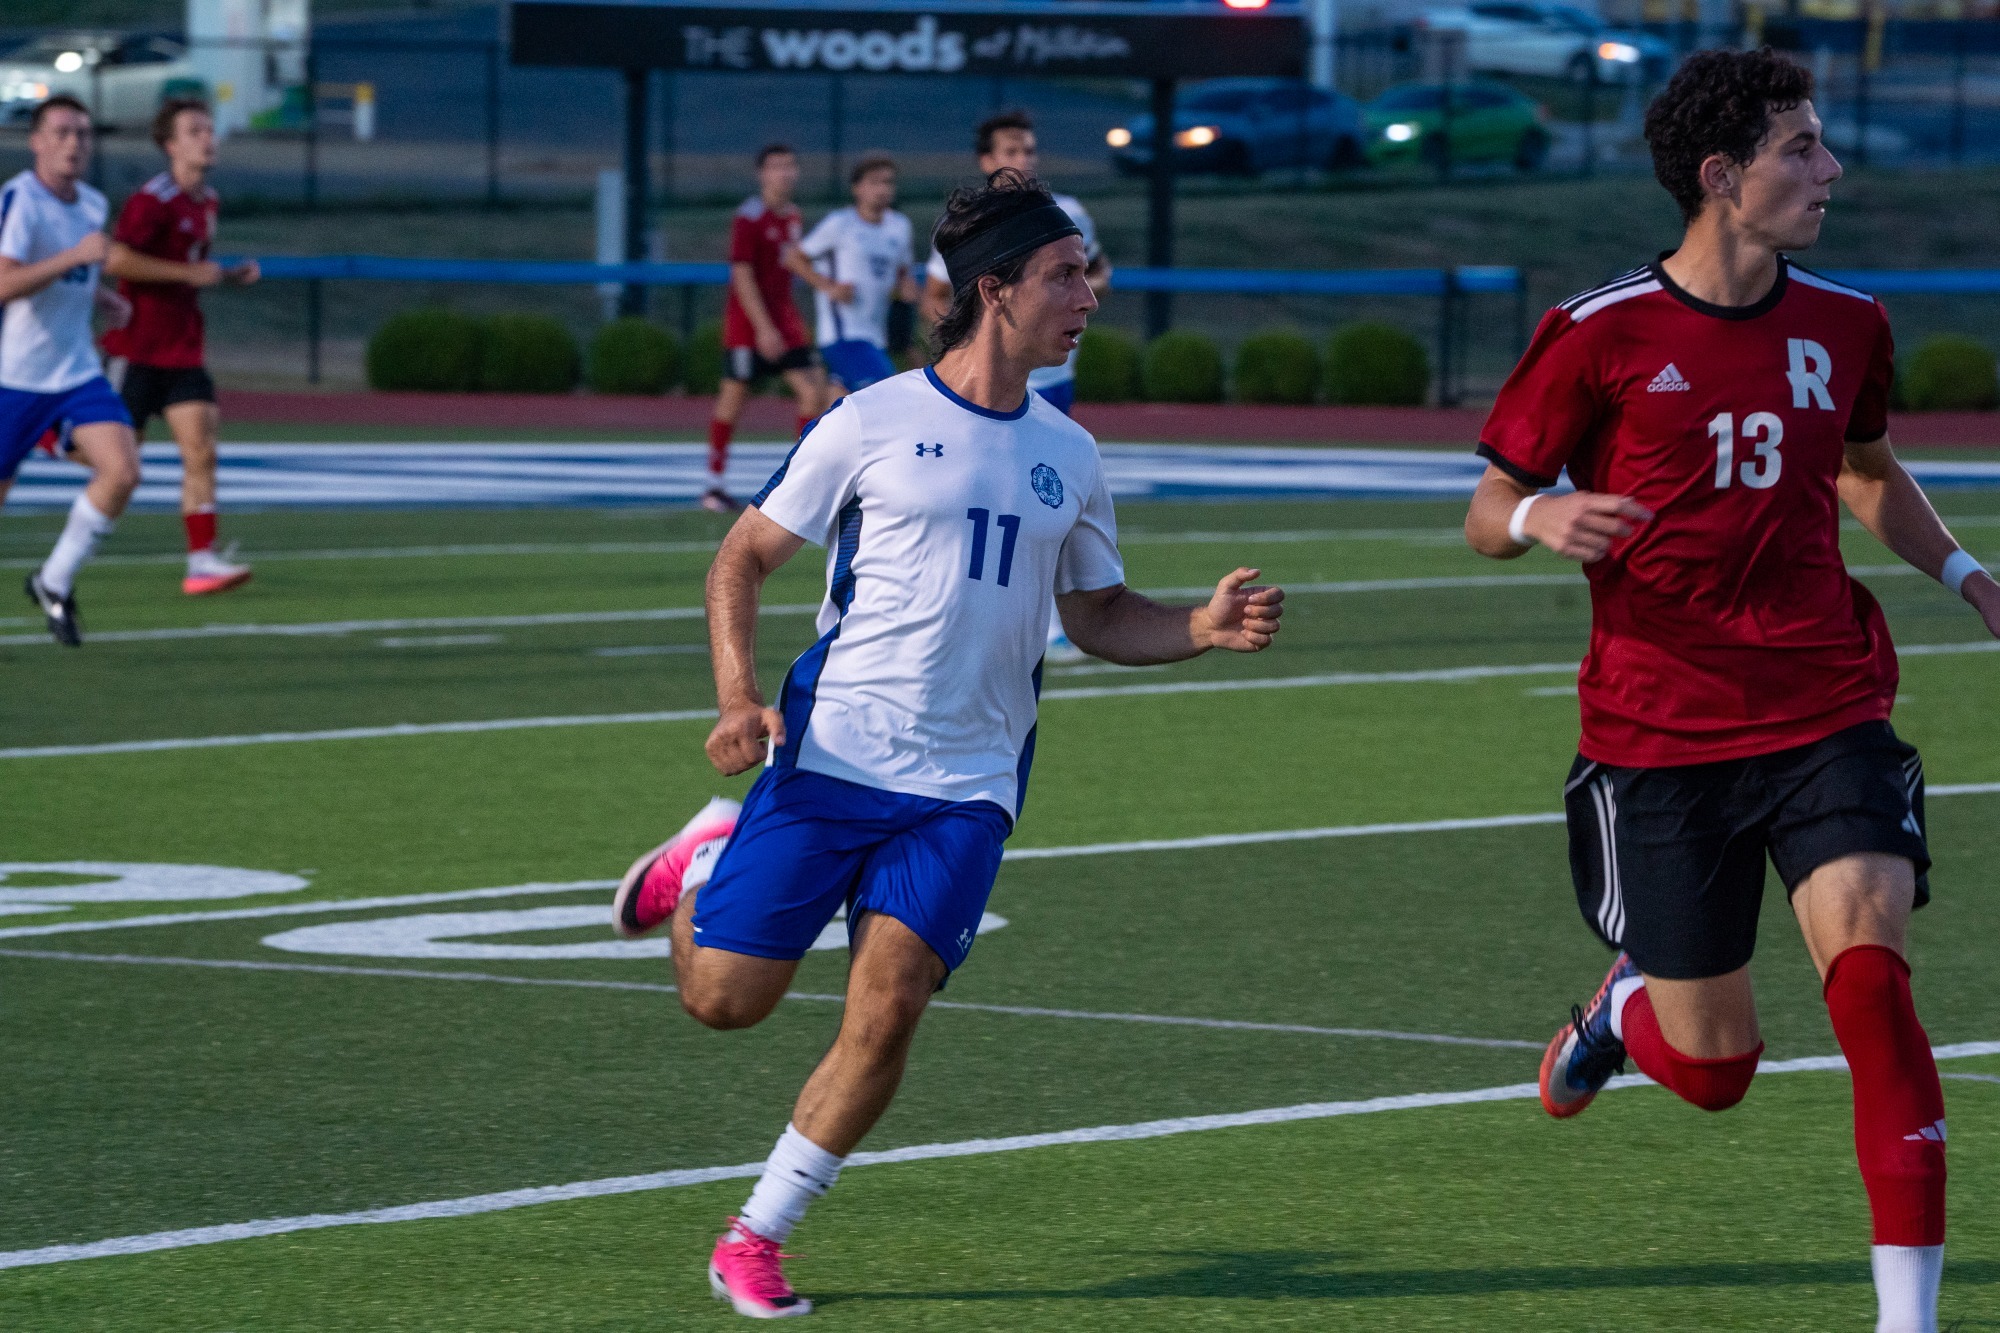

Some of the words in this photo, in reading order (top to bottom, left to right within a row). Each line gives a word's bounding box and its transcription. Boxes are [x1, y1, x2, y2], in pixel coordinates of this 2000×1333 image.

[761, 15, 966, 71] woods
[1647, 381, 1691, 393] adidas
[1785, 338, 1836, 411] R
[1708, 411, 1784, 489] 13
[967, 508, 1021, 587] 11
